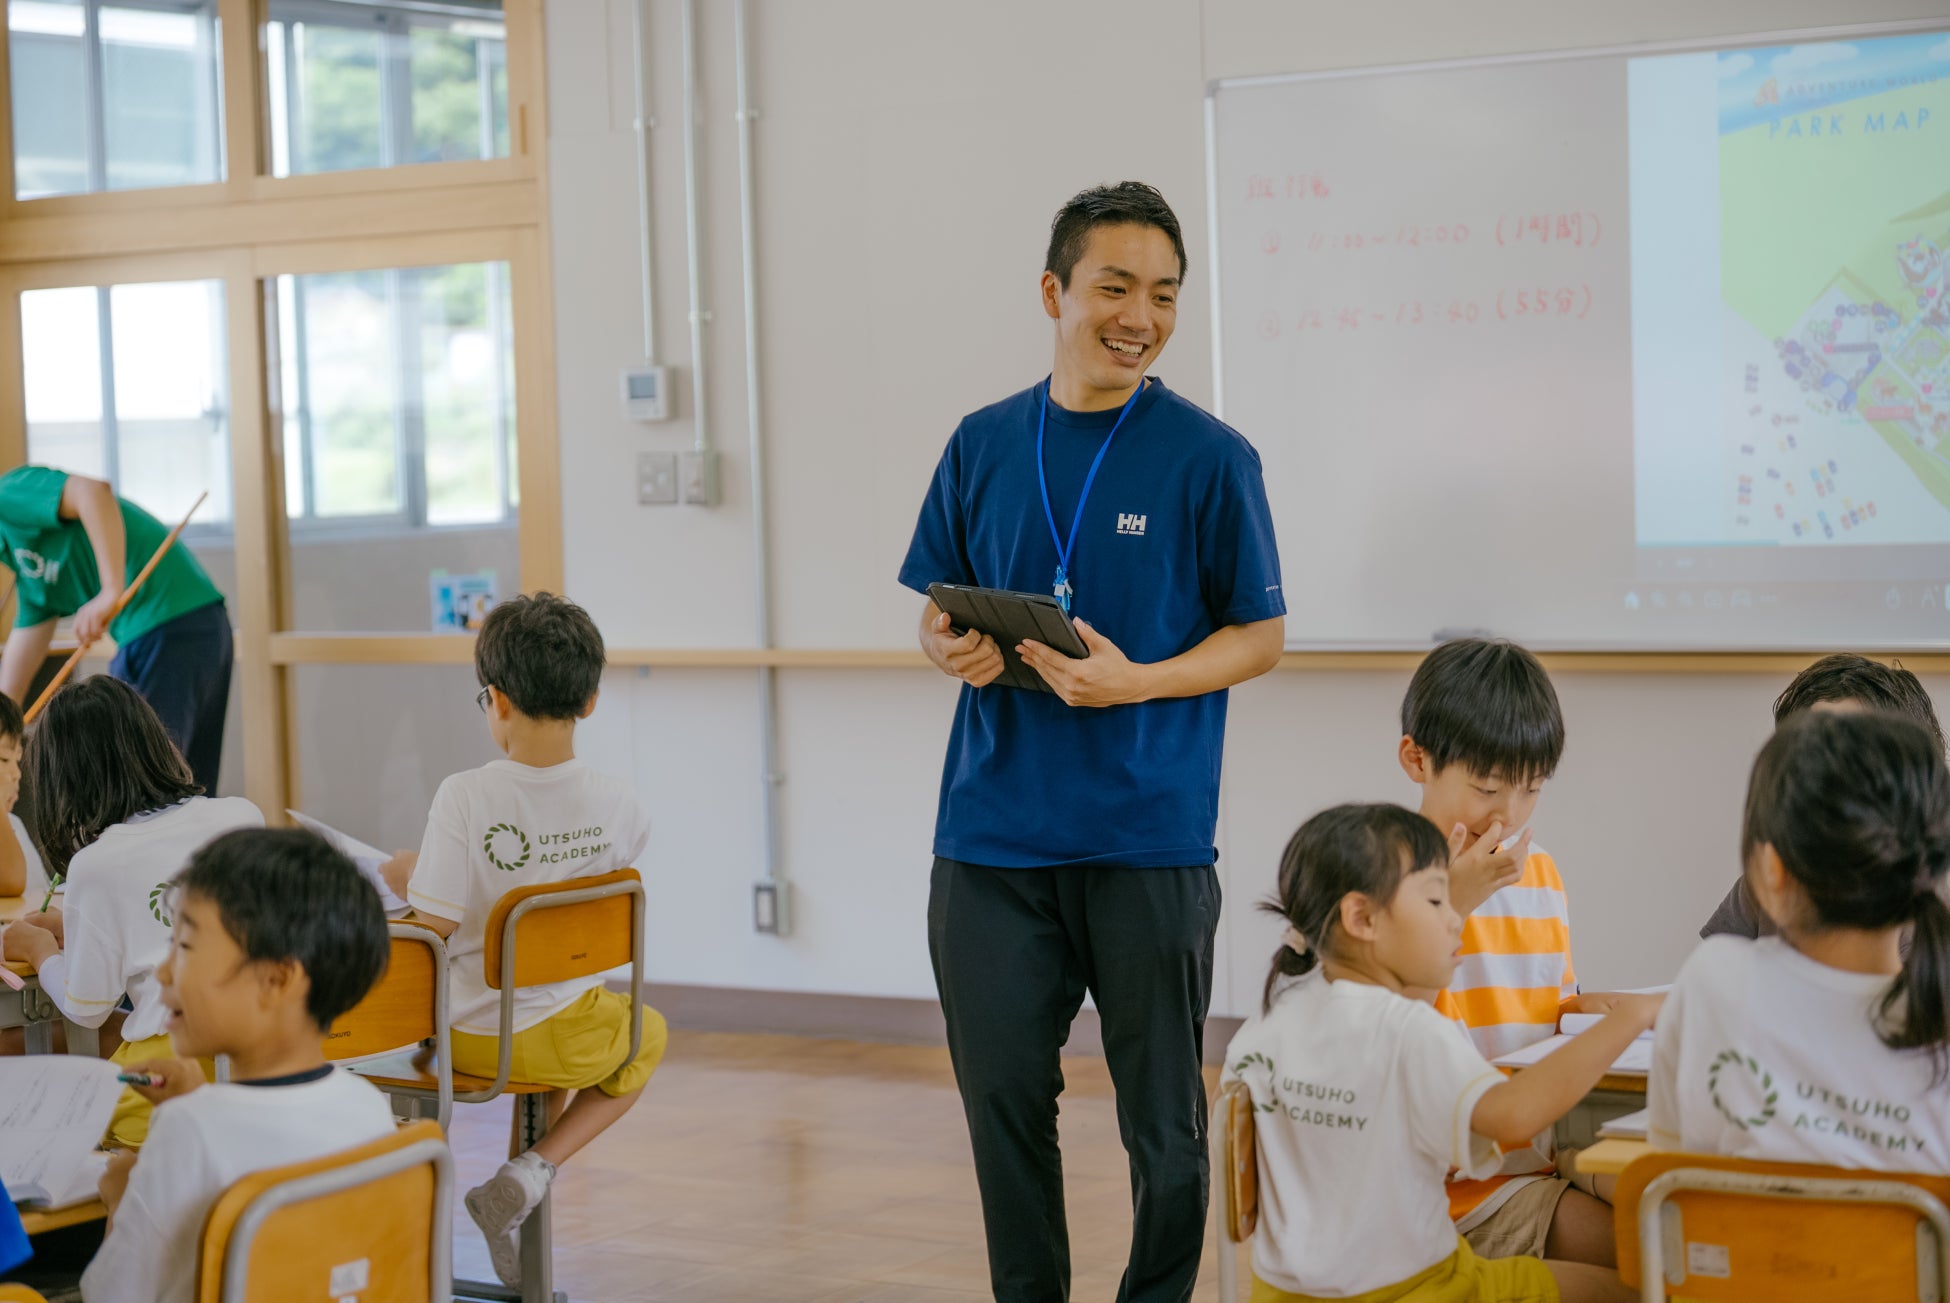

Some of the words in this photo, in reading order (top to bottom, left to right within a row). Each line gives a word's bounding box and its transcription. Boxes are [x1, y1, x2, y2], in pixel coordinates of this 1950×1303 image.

[1769, 113, 1844, 140] PARK
[1864, 107, 1930, 134] MAP
[1117, 513, 1147, 531] HH
[539, 826, 603, 845] UTSUHO
[1283, 1077, 1356, 1104] UTSUHO
[1796, 1081, 1911, 1123] UTSUHO
[1794, 1113, 1925, 1151] ACADEMY
